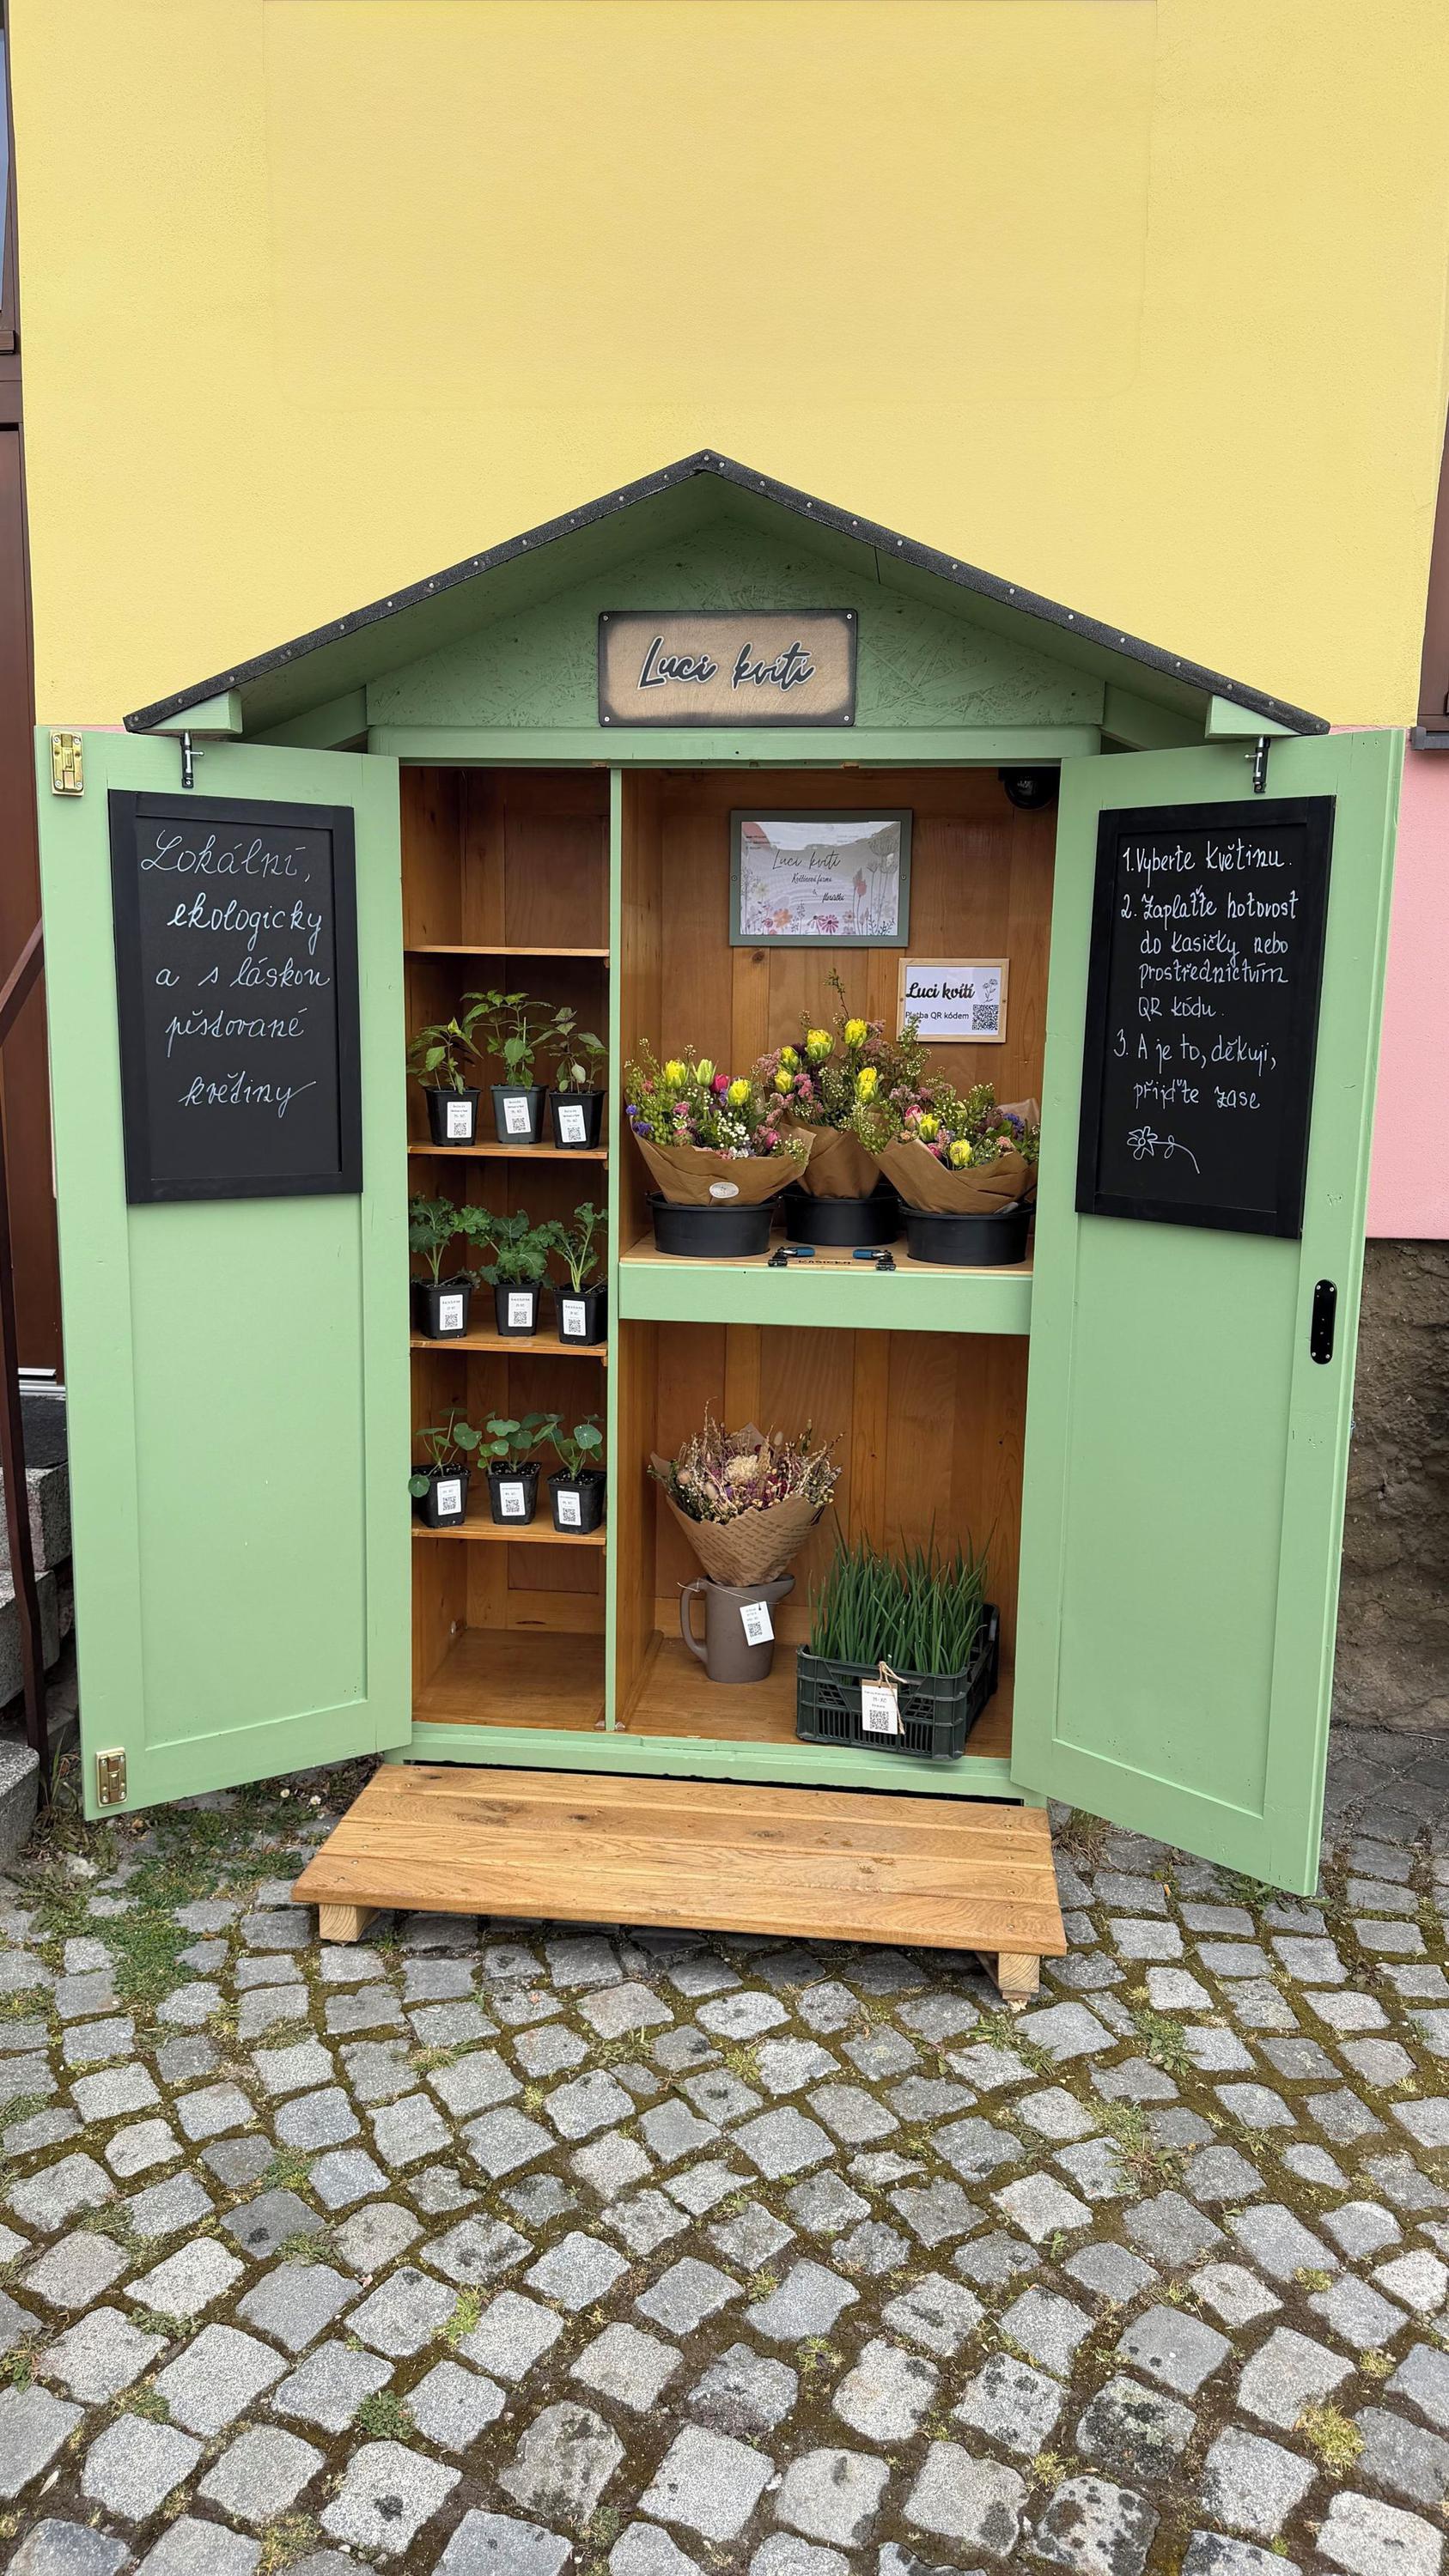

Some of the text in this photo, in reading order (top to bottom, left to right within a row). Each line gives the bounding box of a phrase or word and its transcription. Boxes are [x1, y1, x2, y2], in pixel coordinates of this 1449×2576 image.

[636, 635, 718, 689] Luci
[140, 829, 311, 883] Lokální,
[772, 849, 802, 870] Luci
[1120, 893, 1138, 920] 2.
[1227, 890, 1300, 920] hotovost
[167, 891, 322, 956] ekologicky
[1140, 929, 1288, 967] do kasičky nebo
[155, 956, 331, 987] a s láskou
[1138, 957, 1289, 988] prostřednictvím
[905, 982, 975, 999] Luci kvítí
[930, 1012, 942, 1020] QR
[1138, 996, 1162, 1022] QR
[165, 1007, 307, 1058] pěstované
[1113, 1029, 1276, 1077] 3. A je to, děkuji,
[178, 1071, 316, 1119] květiny
[1133, 1078, 1260, 1109] přijďte zase
